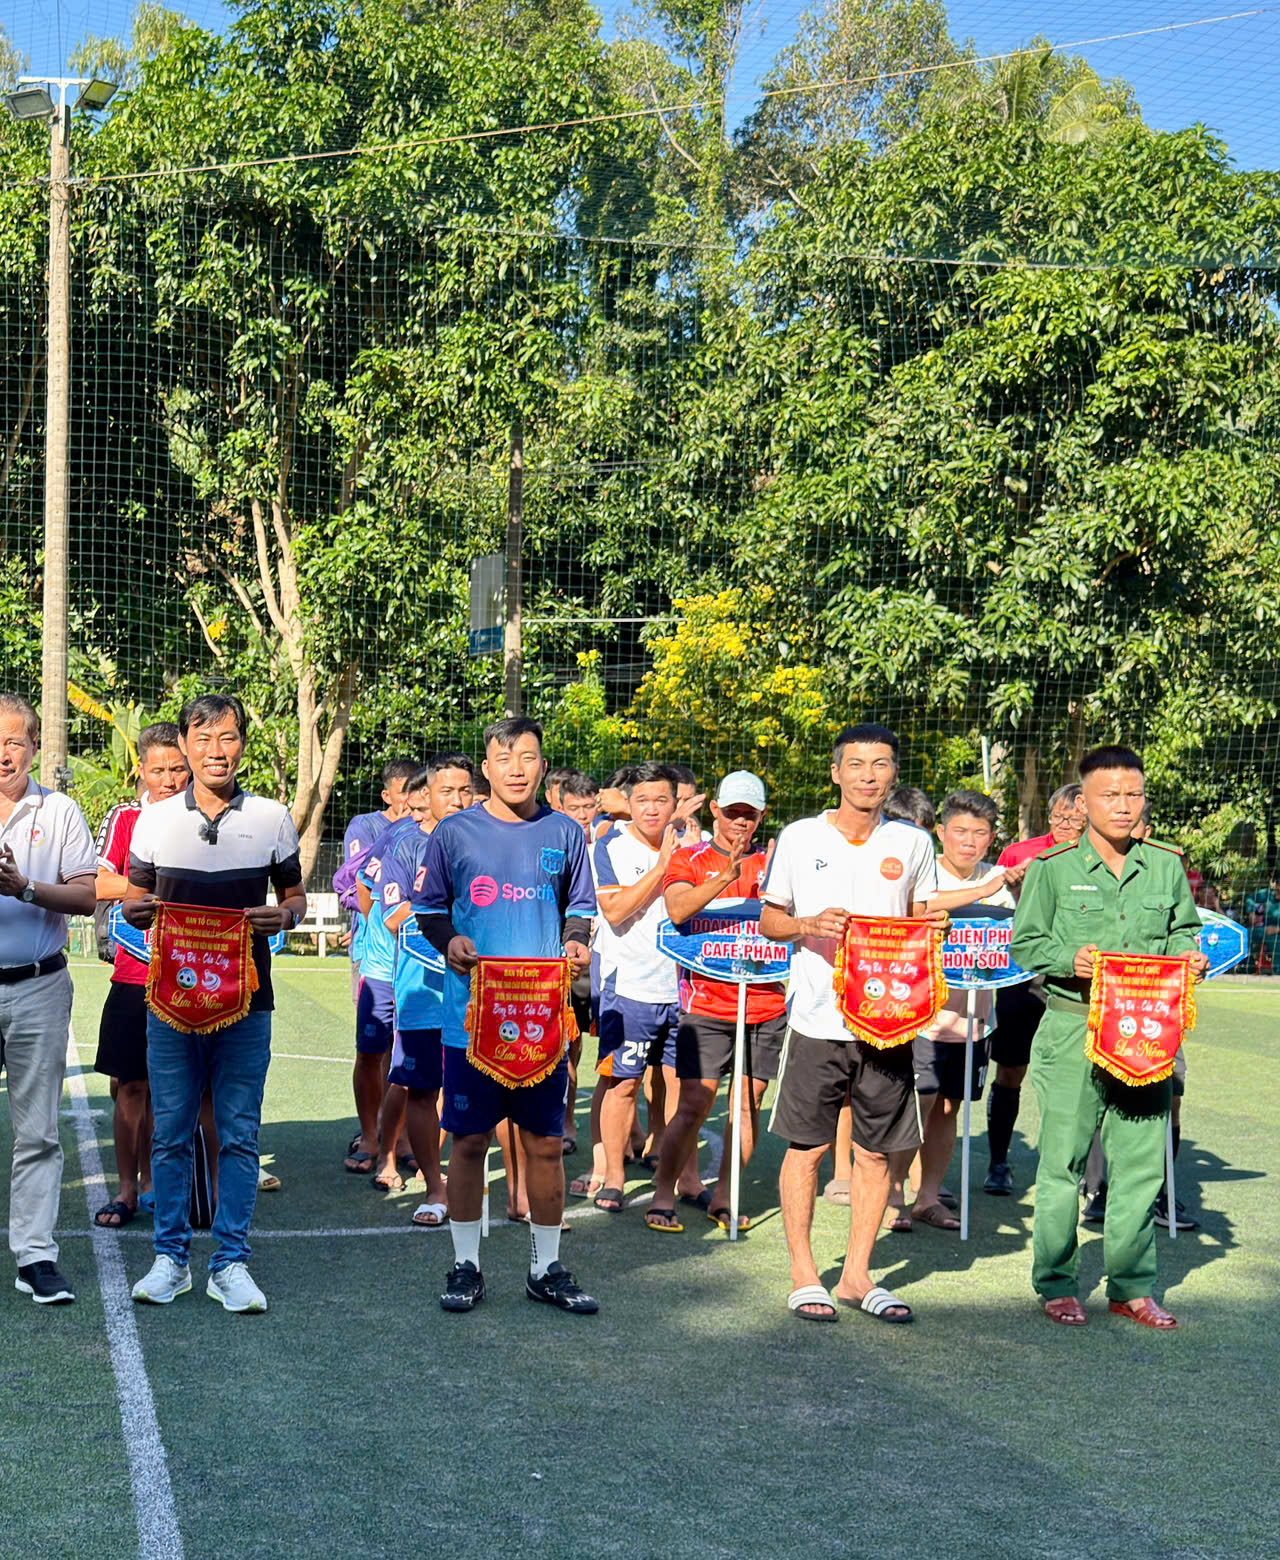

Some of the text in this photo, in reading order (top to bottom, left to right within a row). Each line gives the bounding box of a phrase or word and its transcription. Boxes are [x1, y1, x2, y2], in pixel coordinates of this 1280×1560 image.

[502, 883, 556, 904] Spotify
[186, 914, 222, 927] BAN TỔ CHỨC
[692, 918, 740, 934] DOANH
[950, 925, 983, 944] BIÊN
[703, 942, 787, 963] CAFE PHẠM
[944, 949, 1008, 968] HÒN SƠN
[504, 966, 540, 978] BAN TỔ CHỨC
[195, 992, 224, 1009] Niệm
[519, 1043, 547, 1064] Niệm
